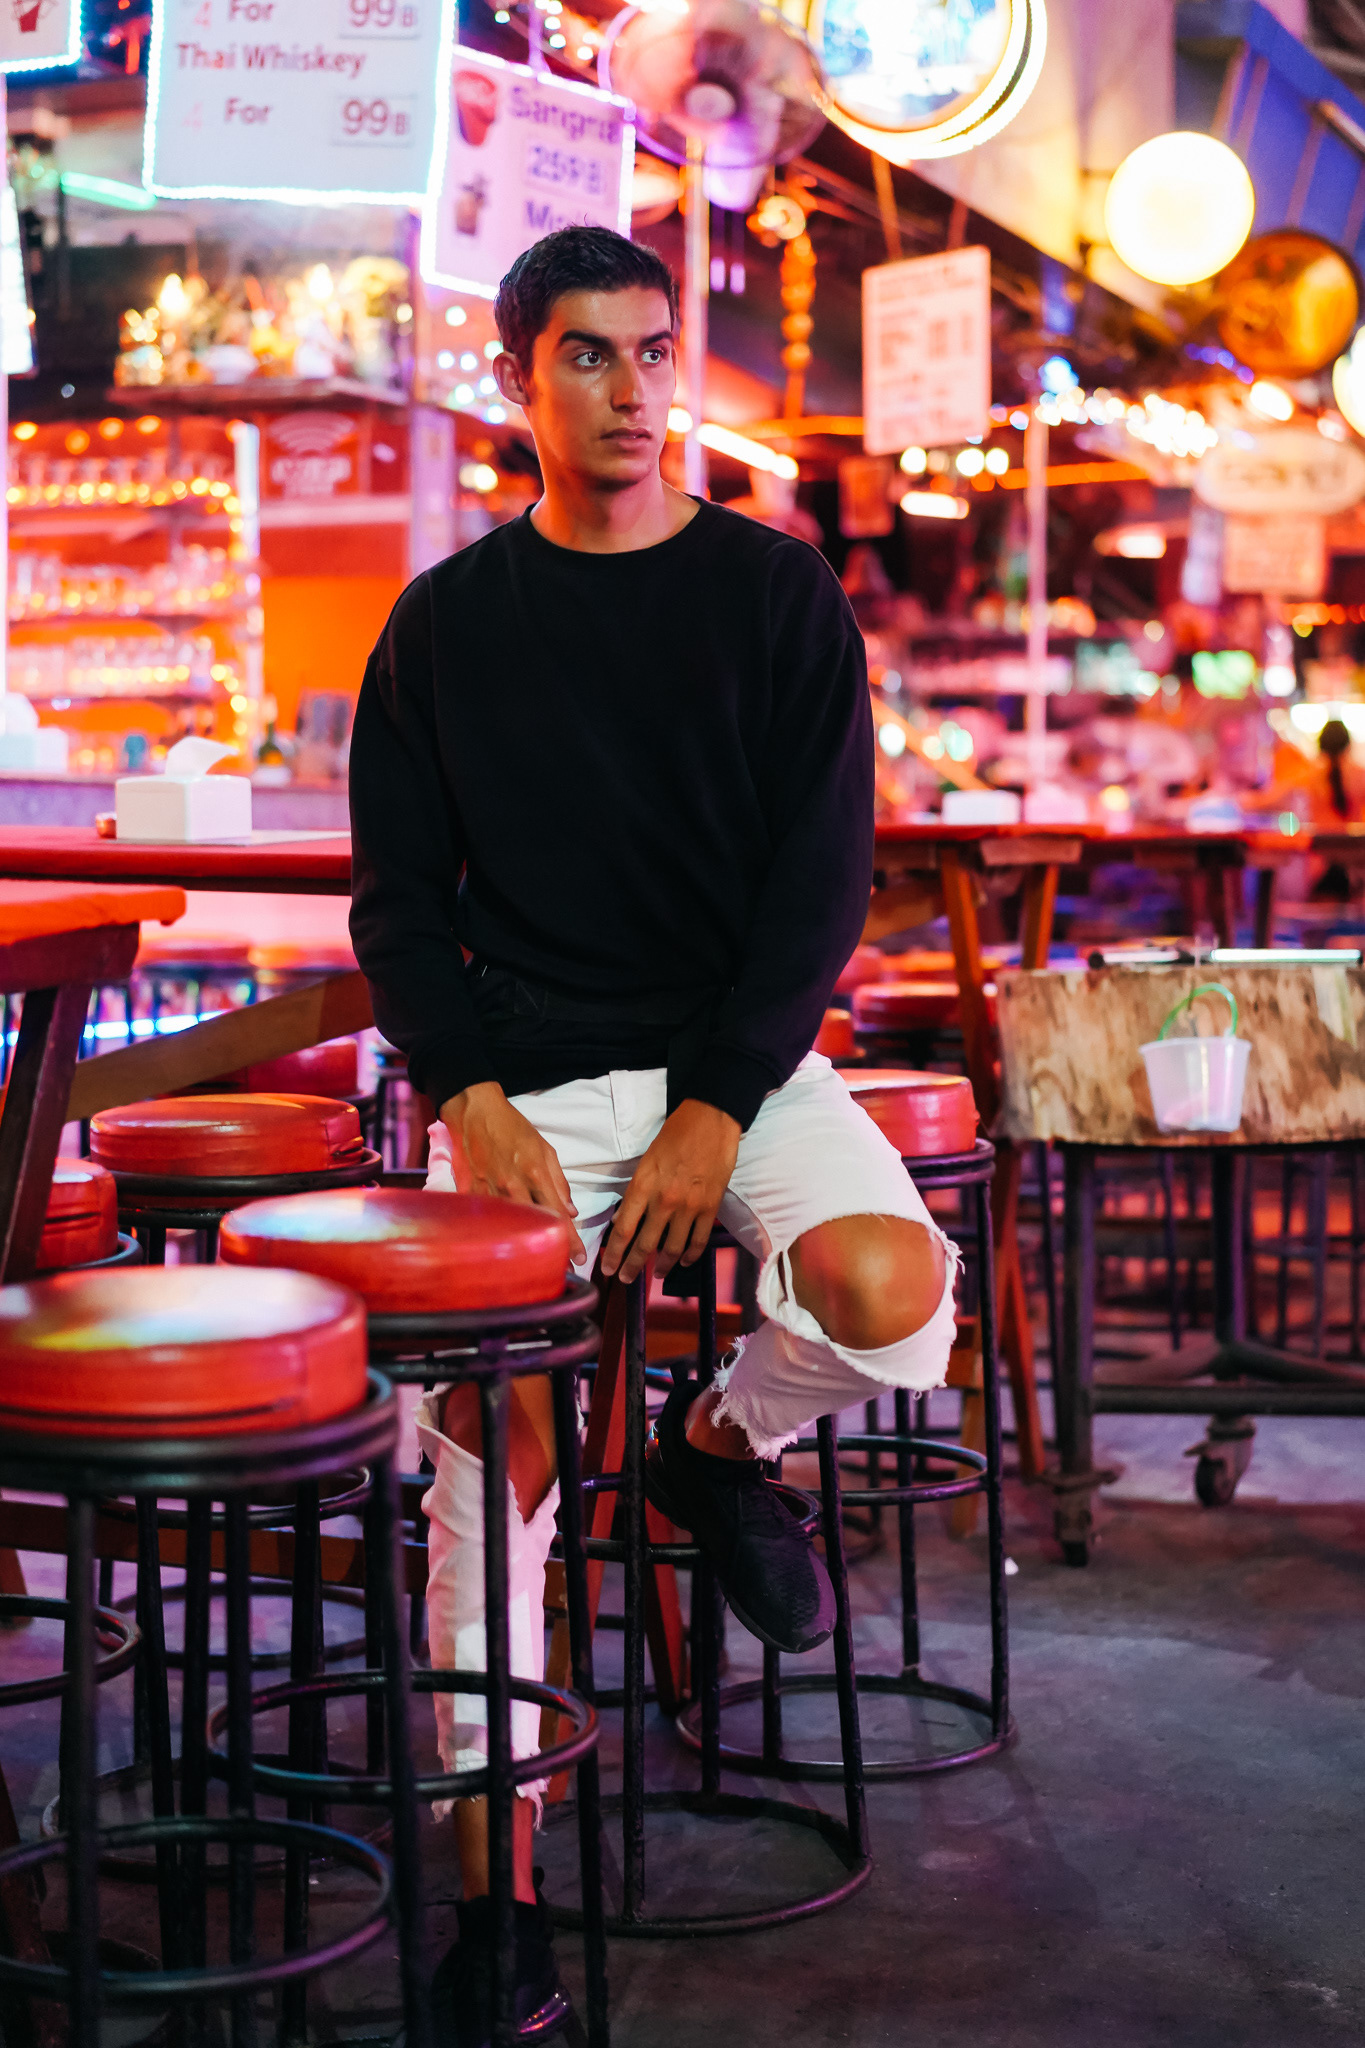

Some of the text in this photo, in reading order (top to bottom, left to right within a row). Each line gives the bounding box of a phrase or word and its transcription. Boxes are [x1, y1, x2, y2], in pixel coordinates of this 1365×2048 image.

[227, 0, 274, 22] For
[177, 42, 366, 80] Thai Whiskey
[223, 97, 273, 125] For
